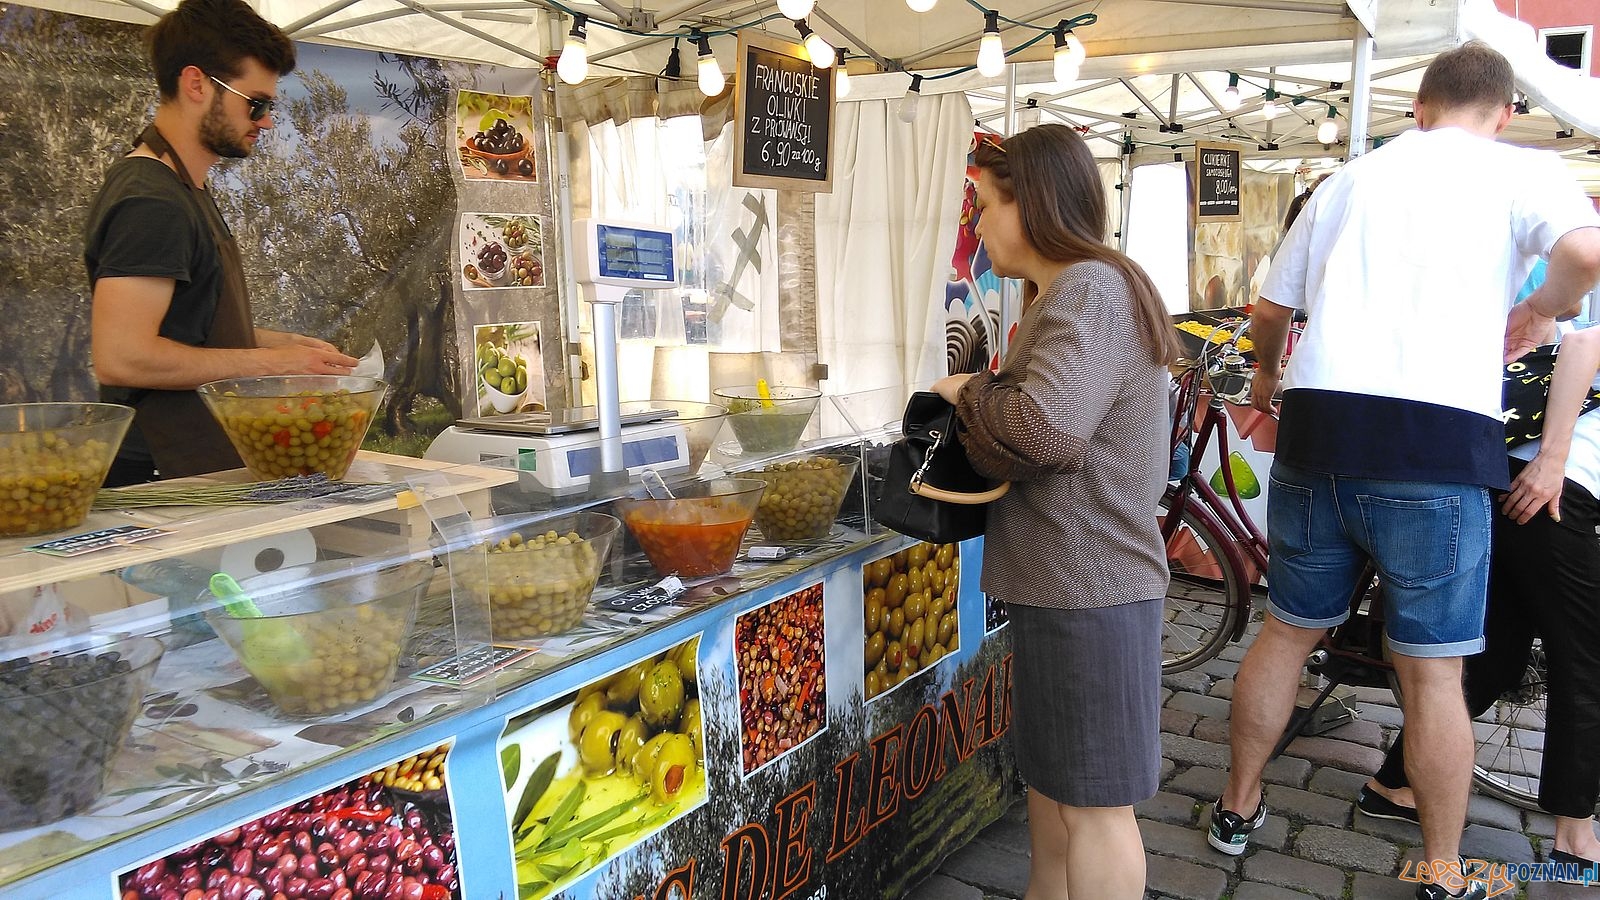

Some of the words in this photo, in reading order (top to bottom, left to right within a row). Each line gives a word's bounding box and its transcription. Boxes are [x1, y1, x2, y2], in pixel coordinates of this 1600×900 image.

[754, 64, 820, 100] FRANCUSKIE
[751, 116, 760, 133] Z
[761, 141, 791, 167] 6,90
[720, 781, 816, 900] DE
